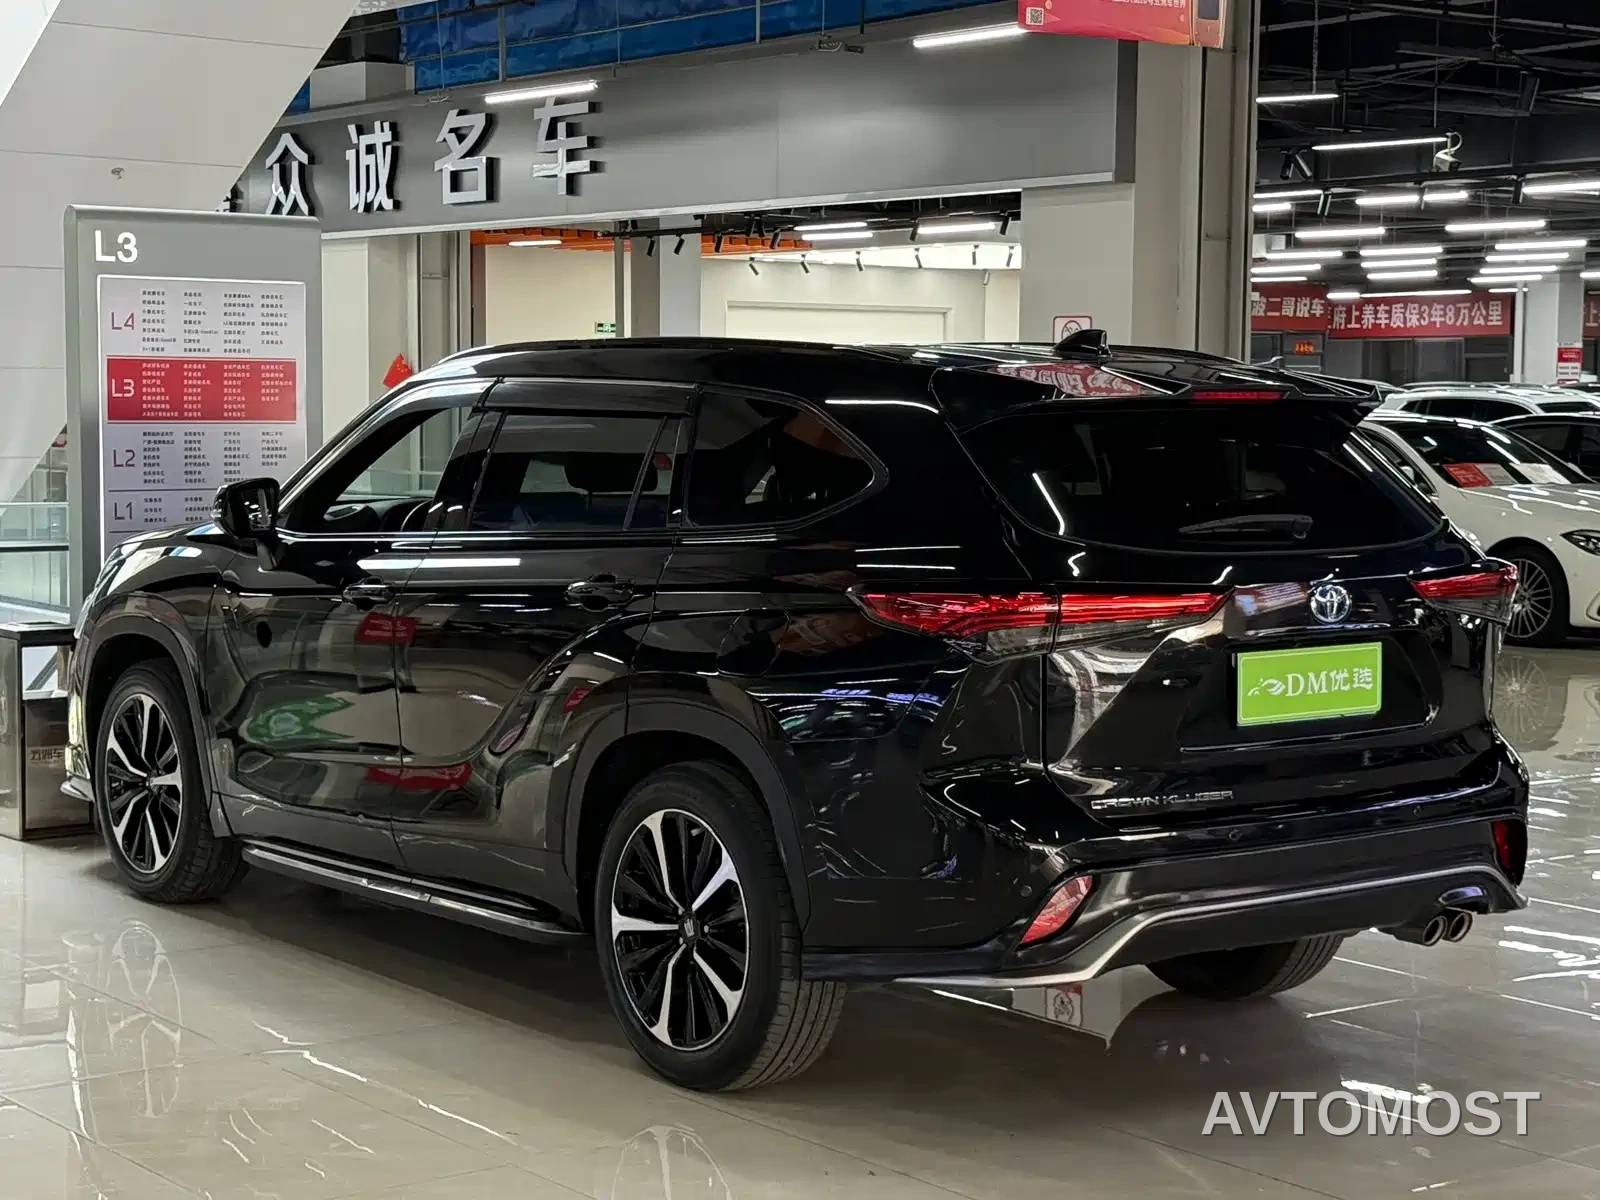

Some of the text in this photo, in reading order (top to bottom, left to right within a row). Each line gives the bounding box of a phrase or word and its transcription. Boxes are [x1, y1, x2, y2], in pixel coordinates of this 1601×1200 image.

[213, 97, 593, 216] 众诚名车
[94, 229, 139, 263] L3
[110, 311, 136, 331] L4
[111, 378, 136, 398] L3
[112, 448, 136, 468] L2
[113, 501, 134, 521] L1
[1285, 667, 1374, 697] DM优选
[1090, 790, 1236, 810] CROWN KLUGER
